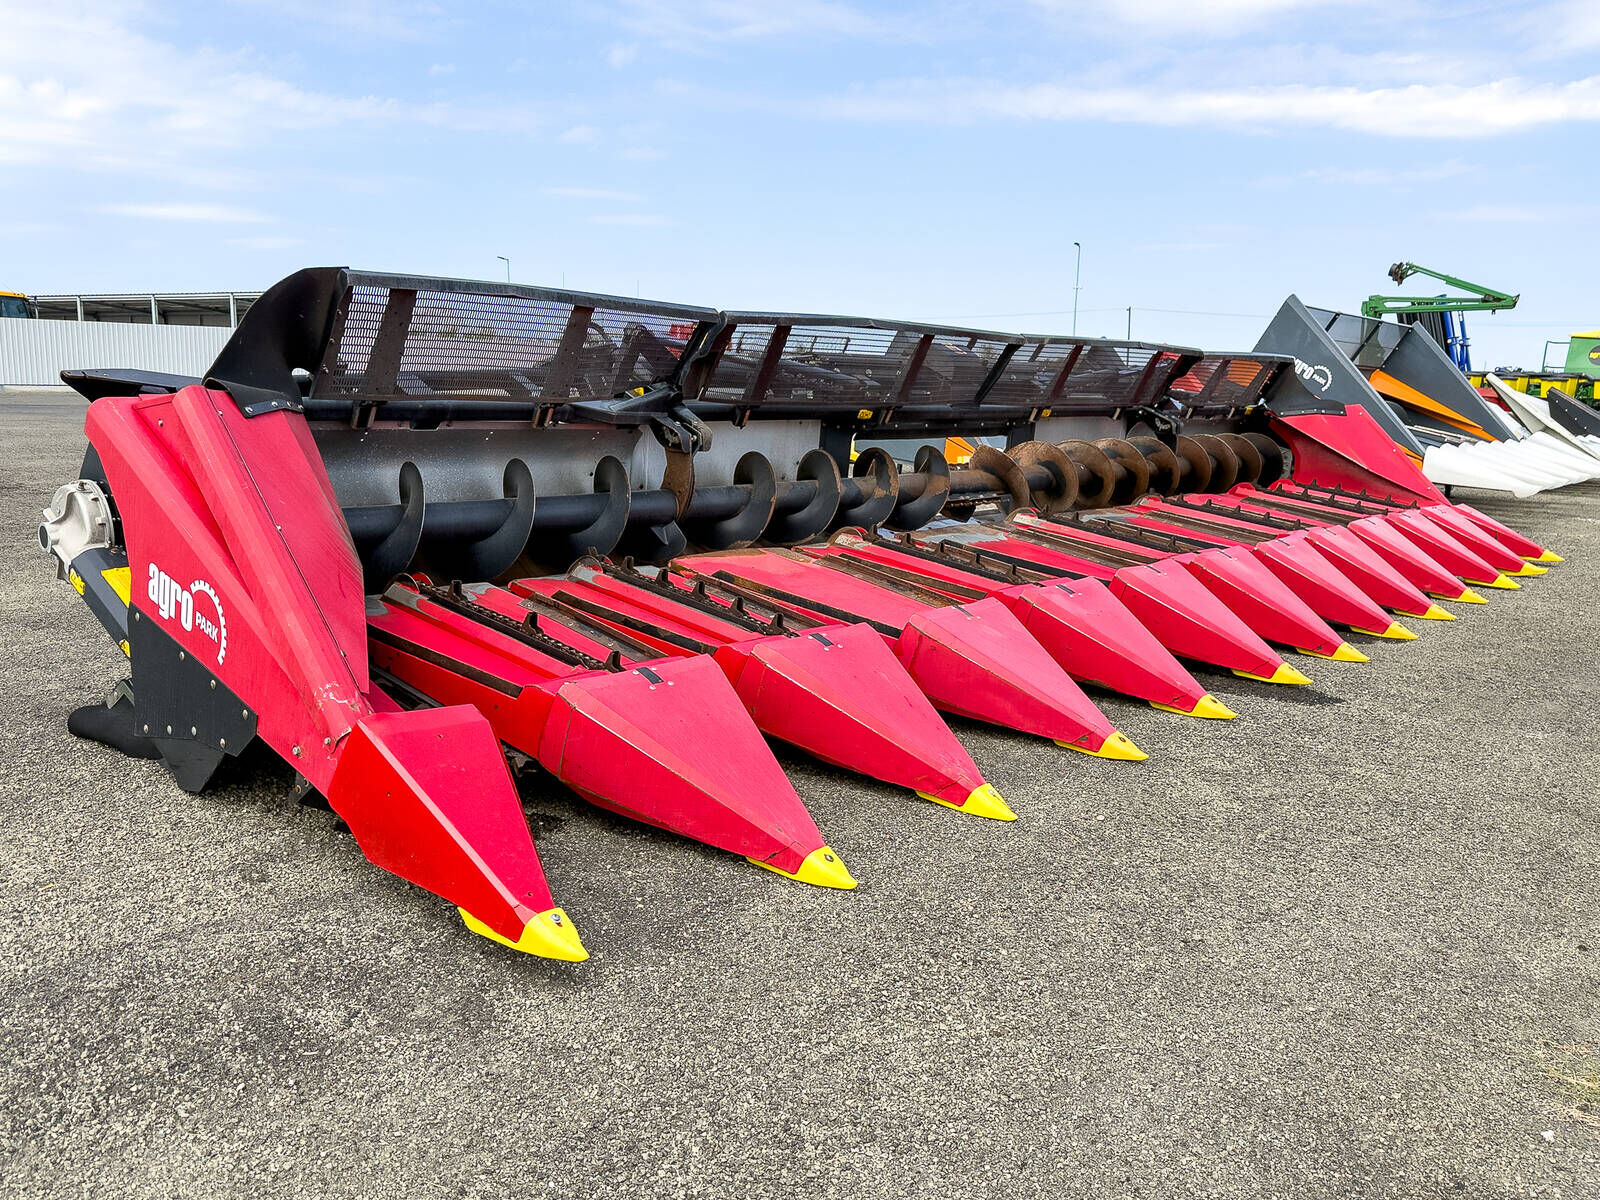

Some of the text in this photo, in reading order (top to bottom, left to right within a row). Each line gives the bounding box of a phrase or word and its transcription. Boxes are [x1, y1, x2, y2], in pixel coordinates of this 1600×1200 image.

[1294, 358, 1315, 380] gro
[147, 562, 219, 644] agro PARK
